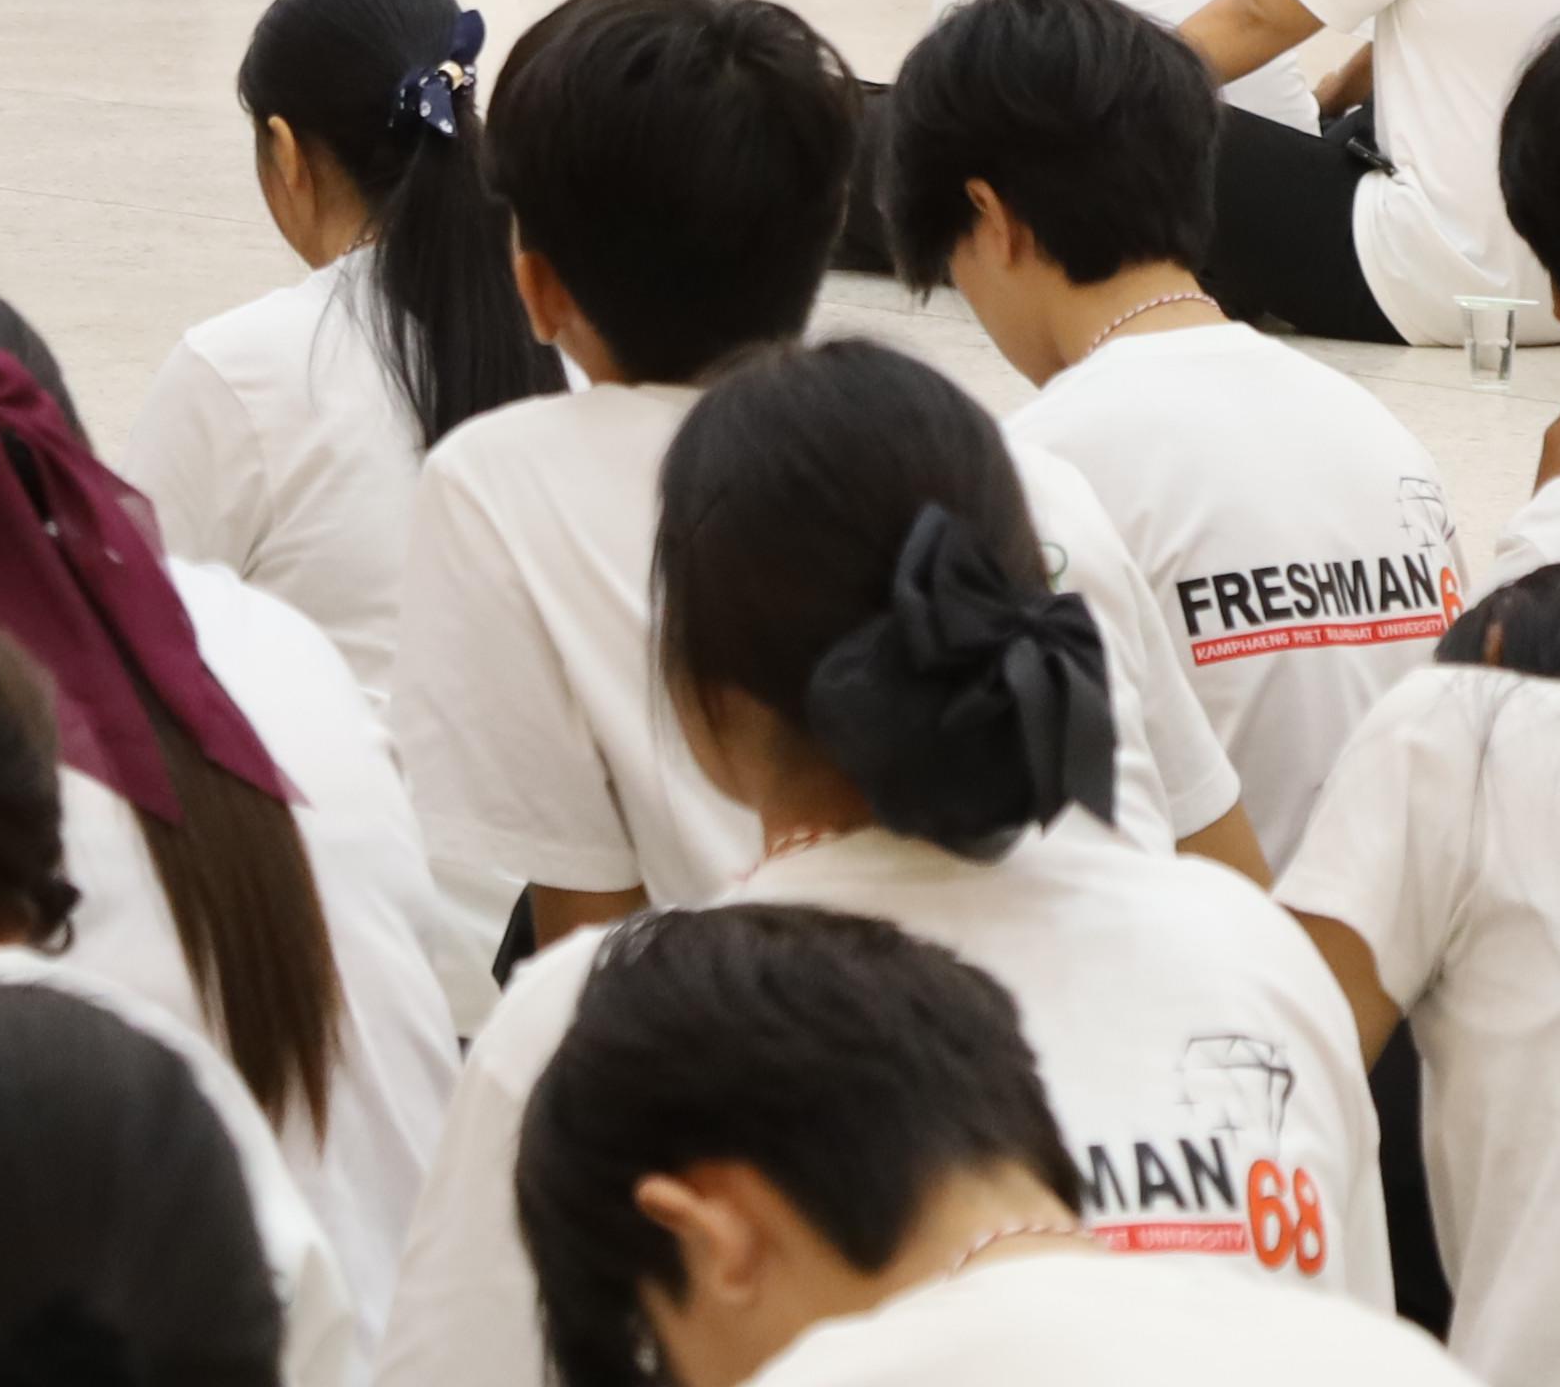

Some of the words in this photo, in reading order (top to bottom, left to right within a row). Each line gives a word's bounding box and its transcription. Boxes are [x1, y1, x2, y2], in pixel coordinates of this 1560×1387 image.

[1176, 552, 1438, 637] FRESHMAN
[1195, 631, 1290, 662] KAMPHAENG
[1293, 629, 1322, 645] PHET
[1376, 618, 1444, 638] UNIVERSITY
[1246, 1158, 1328, 1277] 68
